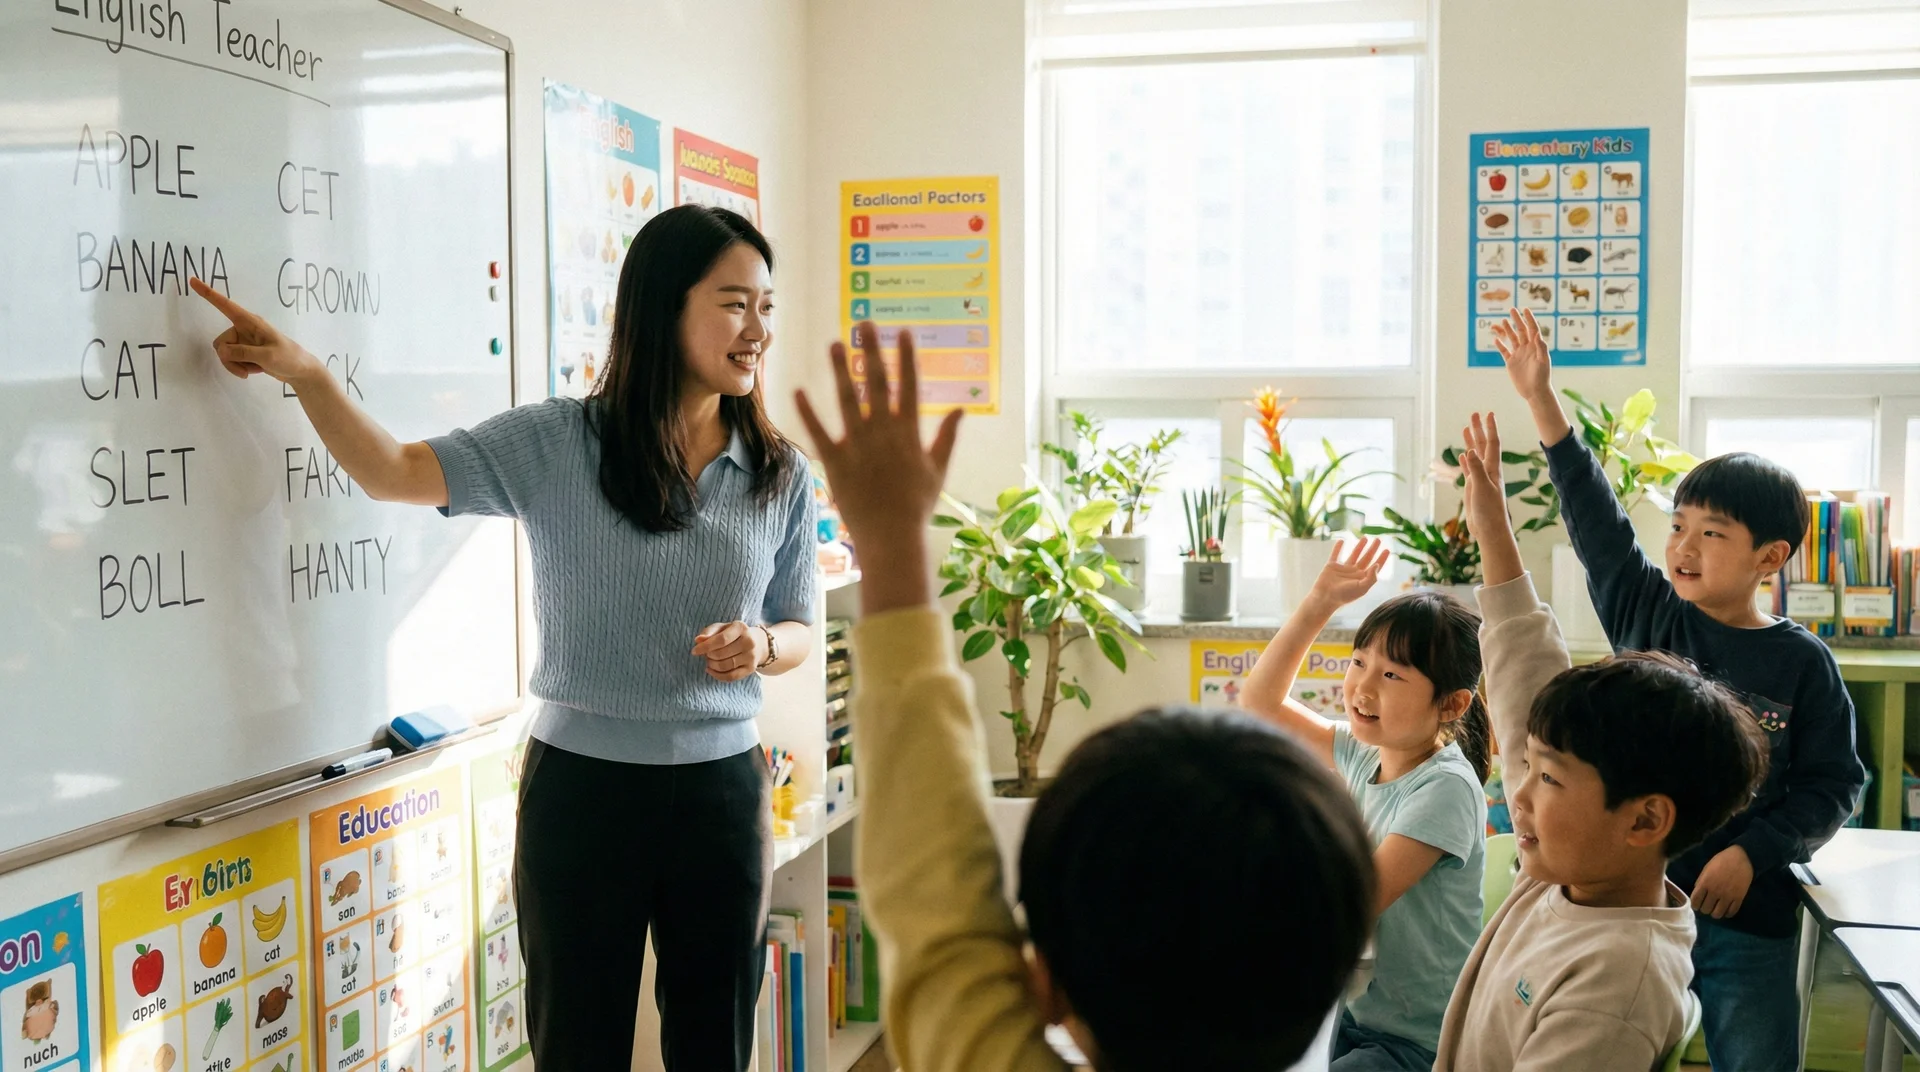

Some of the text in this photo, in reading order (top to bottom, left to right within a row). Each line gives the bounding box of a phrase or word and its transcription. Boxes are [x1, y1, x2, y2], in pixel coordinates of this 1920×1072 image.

[213, 0, 323, 81] Teacher
[73, 123, 198, 199] APPLE
[1593, 136, 1633, 154] Kids
[277, 161, 340, 221] CET
[856, 219, 864, 234] 1
[77, 231, 231, 299] BANANA
[854, 247, 866, 262] 2
[277, 258, 381, 316] GROWN
[854, 274, 866, 290] 3
[855, 303, 865, 317] 4
[80, 338, 167, 401] CAT
[90, 446, 196, 508] SLET
[285, 447, 352, 503] FAR
[99, 550, 206, 620] BOLL
[289, 535, 393, 603] HANTY
[1203, 649, 1258, 676] Engli
[338, 788, 440, 845] Education
[0, 930, 42, 974] on
[264, 945, 281, 963] cat
[193, 967, 236, 995] banana
[341, 977, 357, 995] cat
[132, 997, 167, 1022] apple
[24, 1043, 59, 1069] nuch
